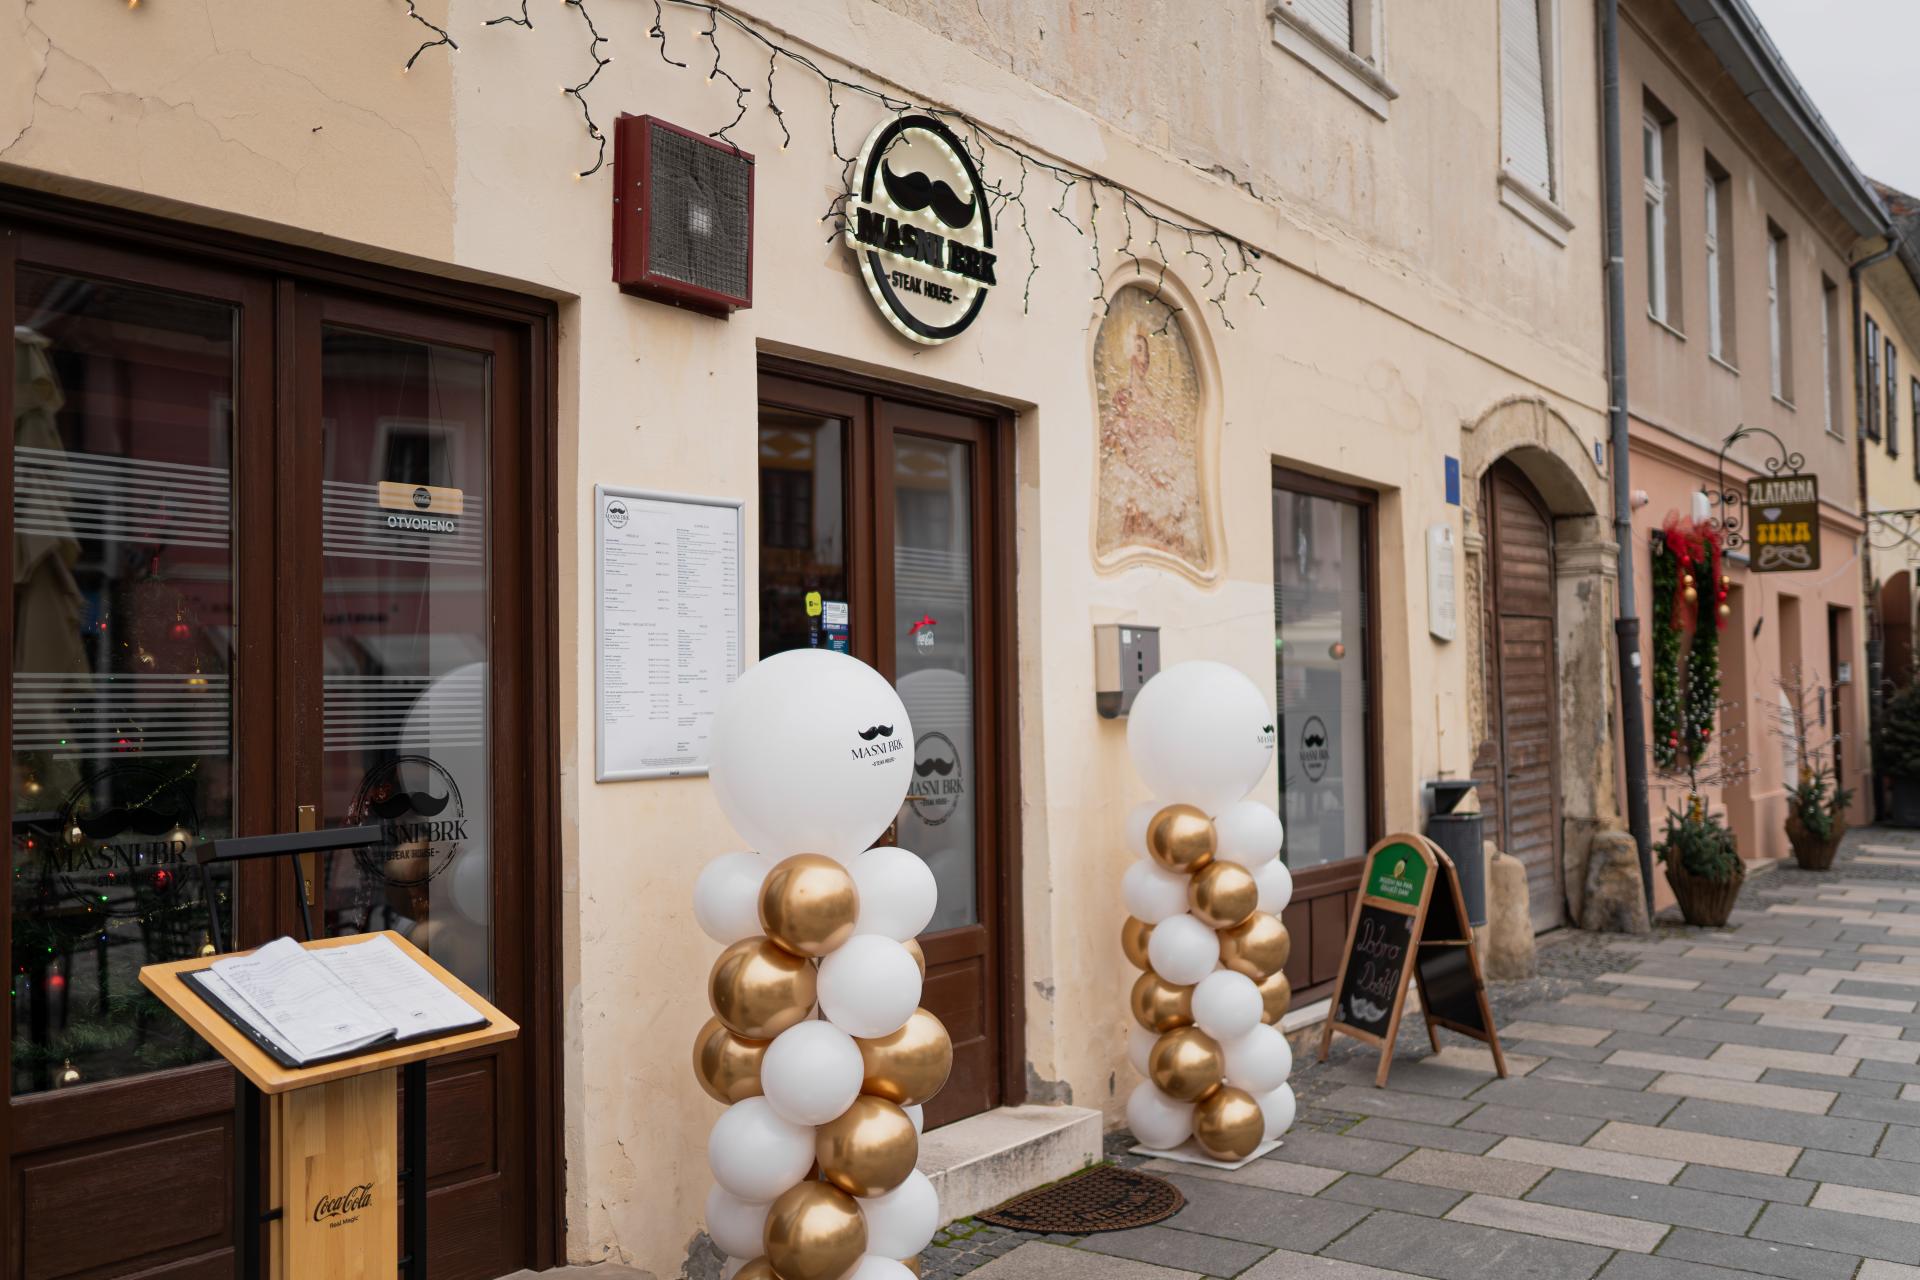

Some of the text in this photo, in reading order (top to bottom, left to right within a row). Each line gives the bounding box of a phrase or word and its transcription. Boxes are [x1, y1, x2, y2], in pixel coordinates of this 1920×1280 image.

[857, 207, 997, 285] MASNI BRK
[892, 271, 952, 304] STEAK HOUSE
[1749, 480, 1816, 505] ZLATARNA
[388, 516, 454, 532] OTVORENO
[1757, 522, 1811, 544] TINA
[851, 743, 886, 760] MASNI
[943, 778, 964, 794] BRK
[428, 819, 468, 842] BRK
[48, 843, 141, 874] MASNI
[1357, 918, 1401, 960] Dobro
[313, 1182, 374, 1222] Coca-Cola
[329, 1216, 360, 1229] Real Magic
